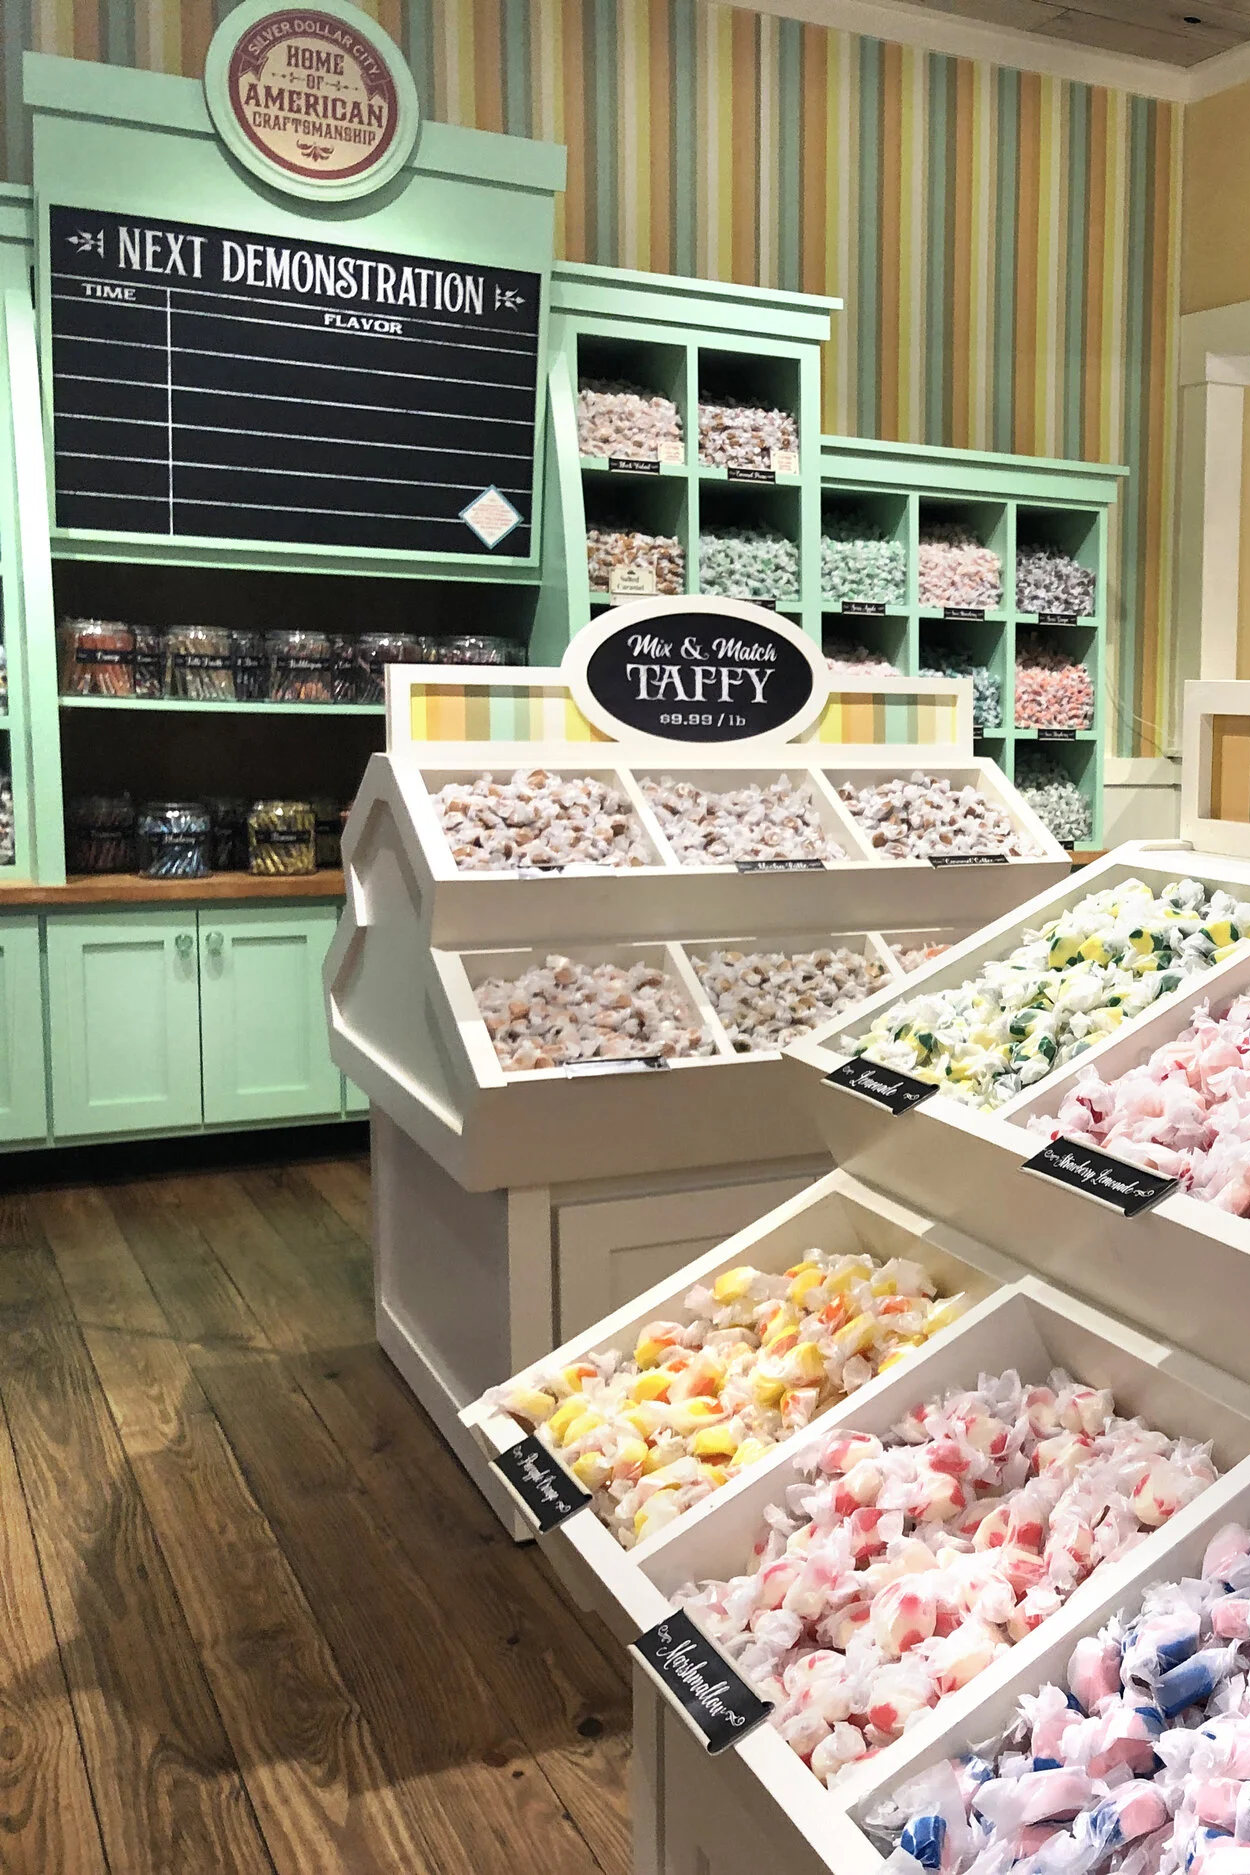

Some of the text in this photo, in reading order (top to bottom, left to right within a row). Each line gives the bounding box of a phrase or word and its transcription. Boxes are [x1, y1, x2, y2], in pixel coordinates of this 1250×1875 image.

[248, 19, 380, 75] SILVER DOLLAR CITY
[286, 44, 345, 76] HOME
[306, 74, 325, 91] OF
[244, 82, 384, 129] AMERICAN
[252, 111, 377, 146] CRAFTSMANSHIP
[118, 226, 485, 315] NEXT DEMONSTRATION
[81, 282, 137, 302] TIME
[324, 313, 403, 335] FLAVOR
[627, 634, 778, 662] Mix & Match
[626, 663, 776, 704] TAFFY
[659, 713, 746, 727] $9.99 / lb
[849, 1070, 904, 1097] Lemonade
[1055, 1153, 1140, 1195] Strawberry Lemonade
[656, 1639, 729, 1718] Marshmallow
